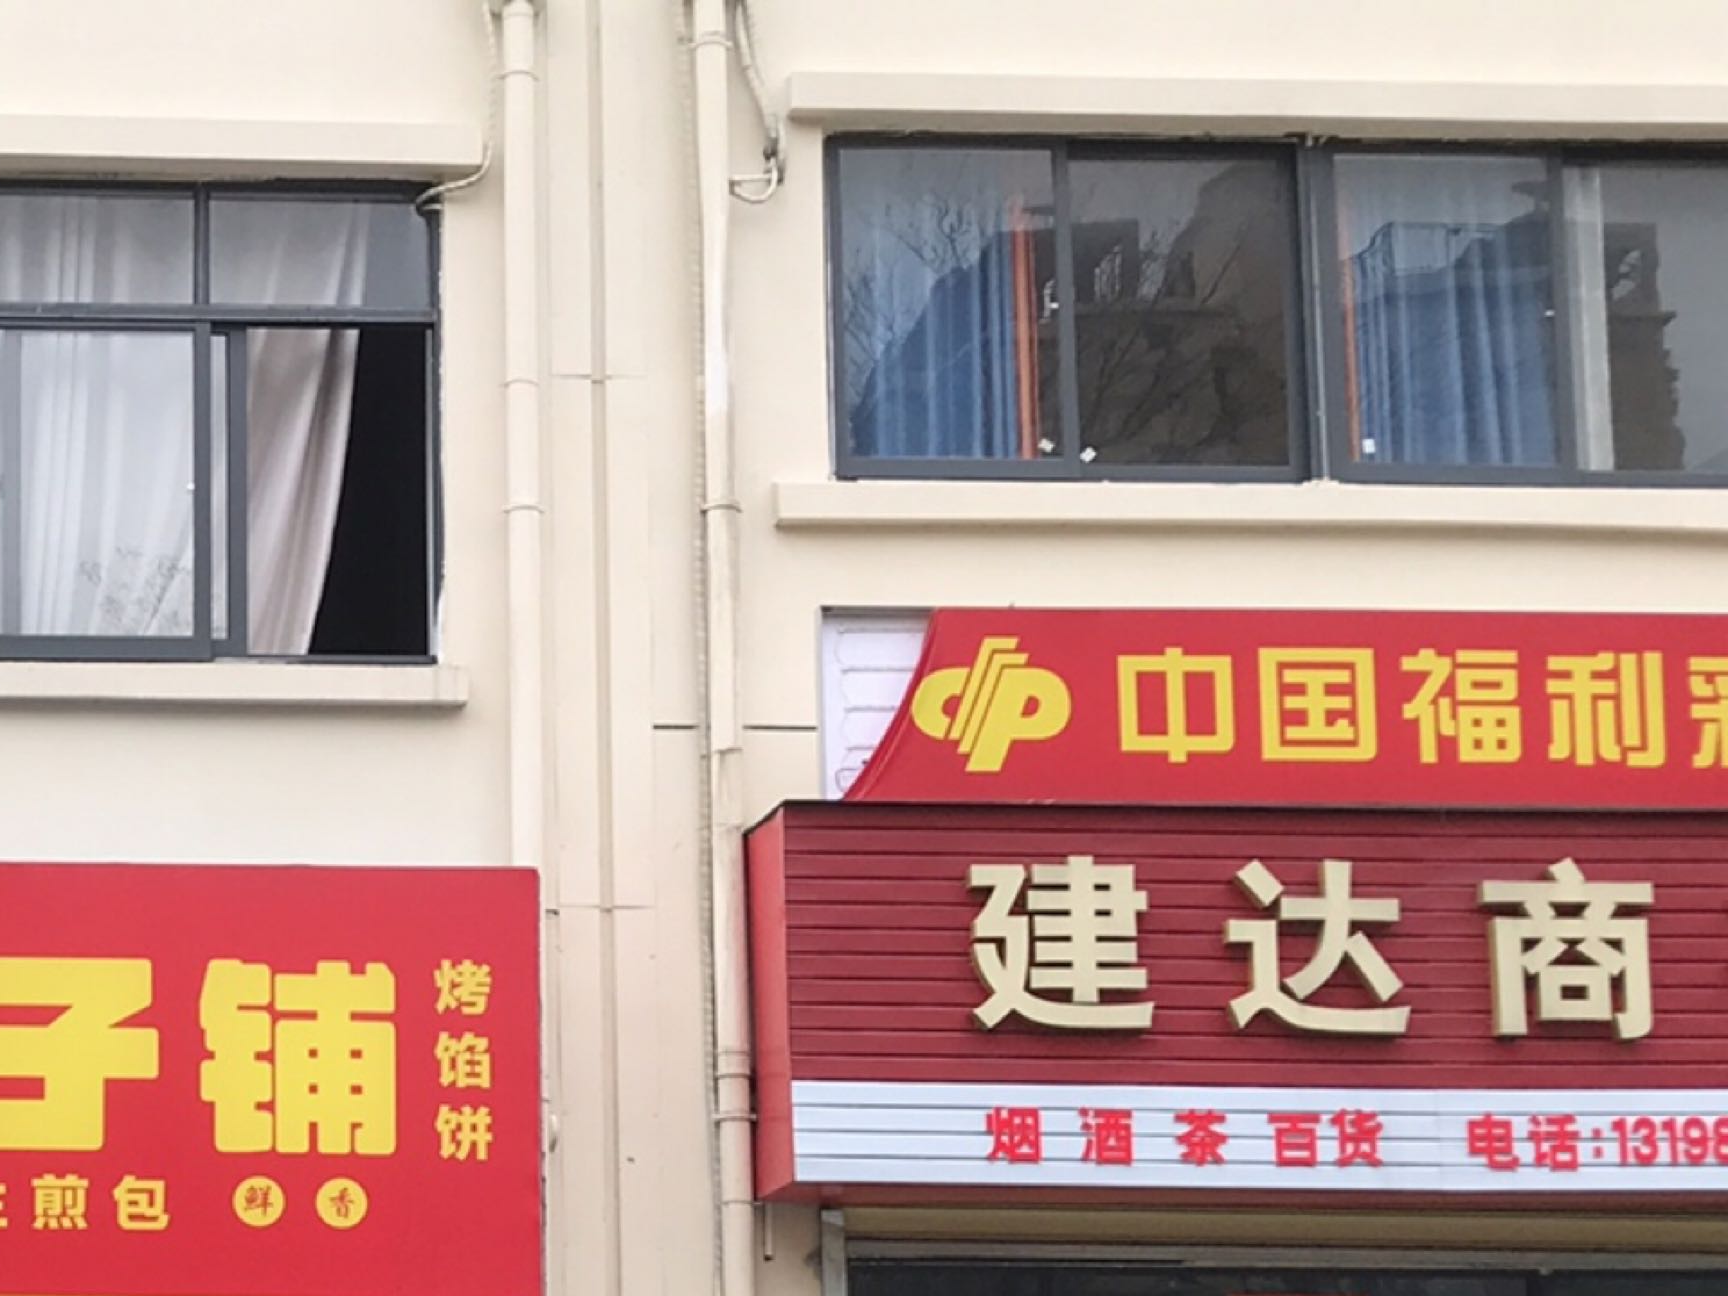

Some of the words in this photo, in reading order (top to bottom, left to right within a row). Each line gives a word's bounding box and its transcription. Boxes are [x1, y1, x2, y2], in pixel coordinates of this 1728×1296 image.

[966, 855, 1654, 1040] 建达商
[433, 959, 492, 1161] 烤馅饼
